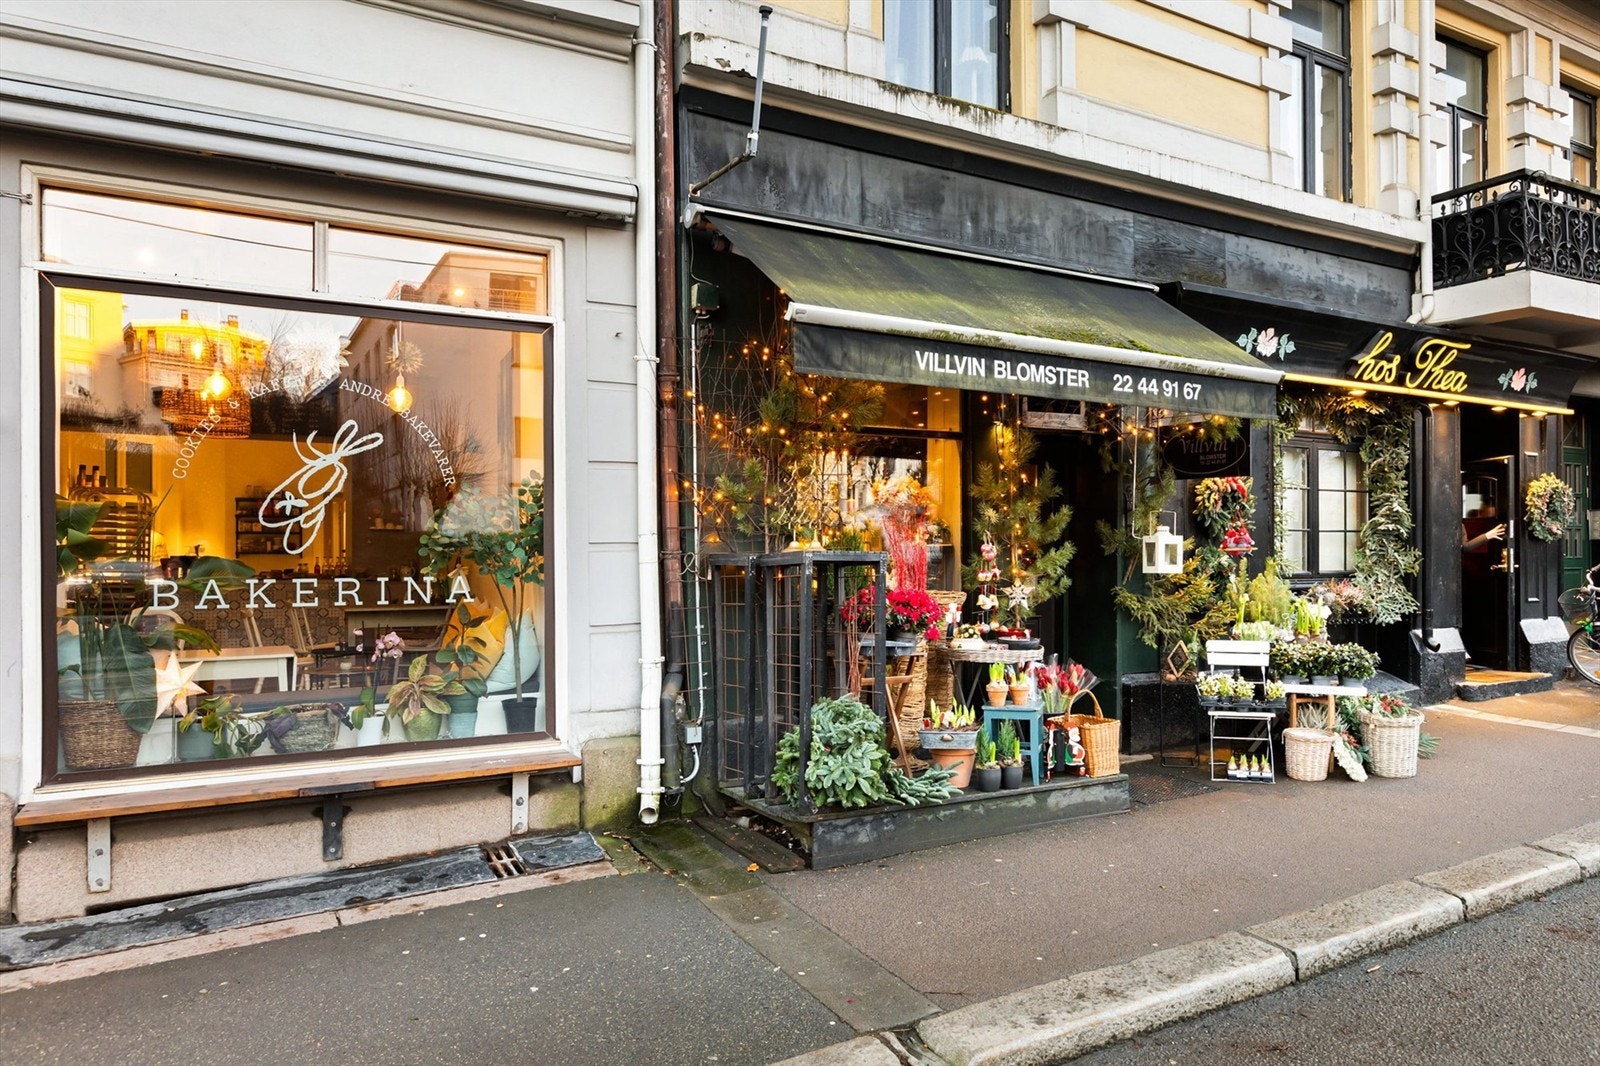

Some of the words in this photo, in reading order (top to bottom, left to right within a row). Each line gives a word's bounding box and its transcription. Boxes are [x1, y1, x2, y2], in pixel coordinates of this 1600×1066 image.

[915, 350, 986, 377] VILLVIN
[993, 360, 1090, 388] BLOMSTER
[1113, 374, 1133, 392] 22
[1138, 377, 1159, 395] 44
[1162, 379, 1179, 398] 91
[1183, 382, 1202, 400] 67
[1355, 332, 1401, 383] hos
[1406, 338, 1471, 393] Thea
[172, 412, 221, 479] COOKIES
[227, 397, 240, 409] &
[339, 378, 392, 407] ANDRE
[398, 408, 456, 487] BAKEVARER
[148, 576, 476, 611] BAKERINA
